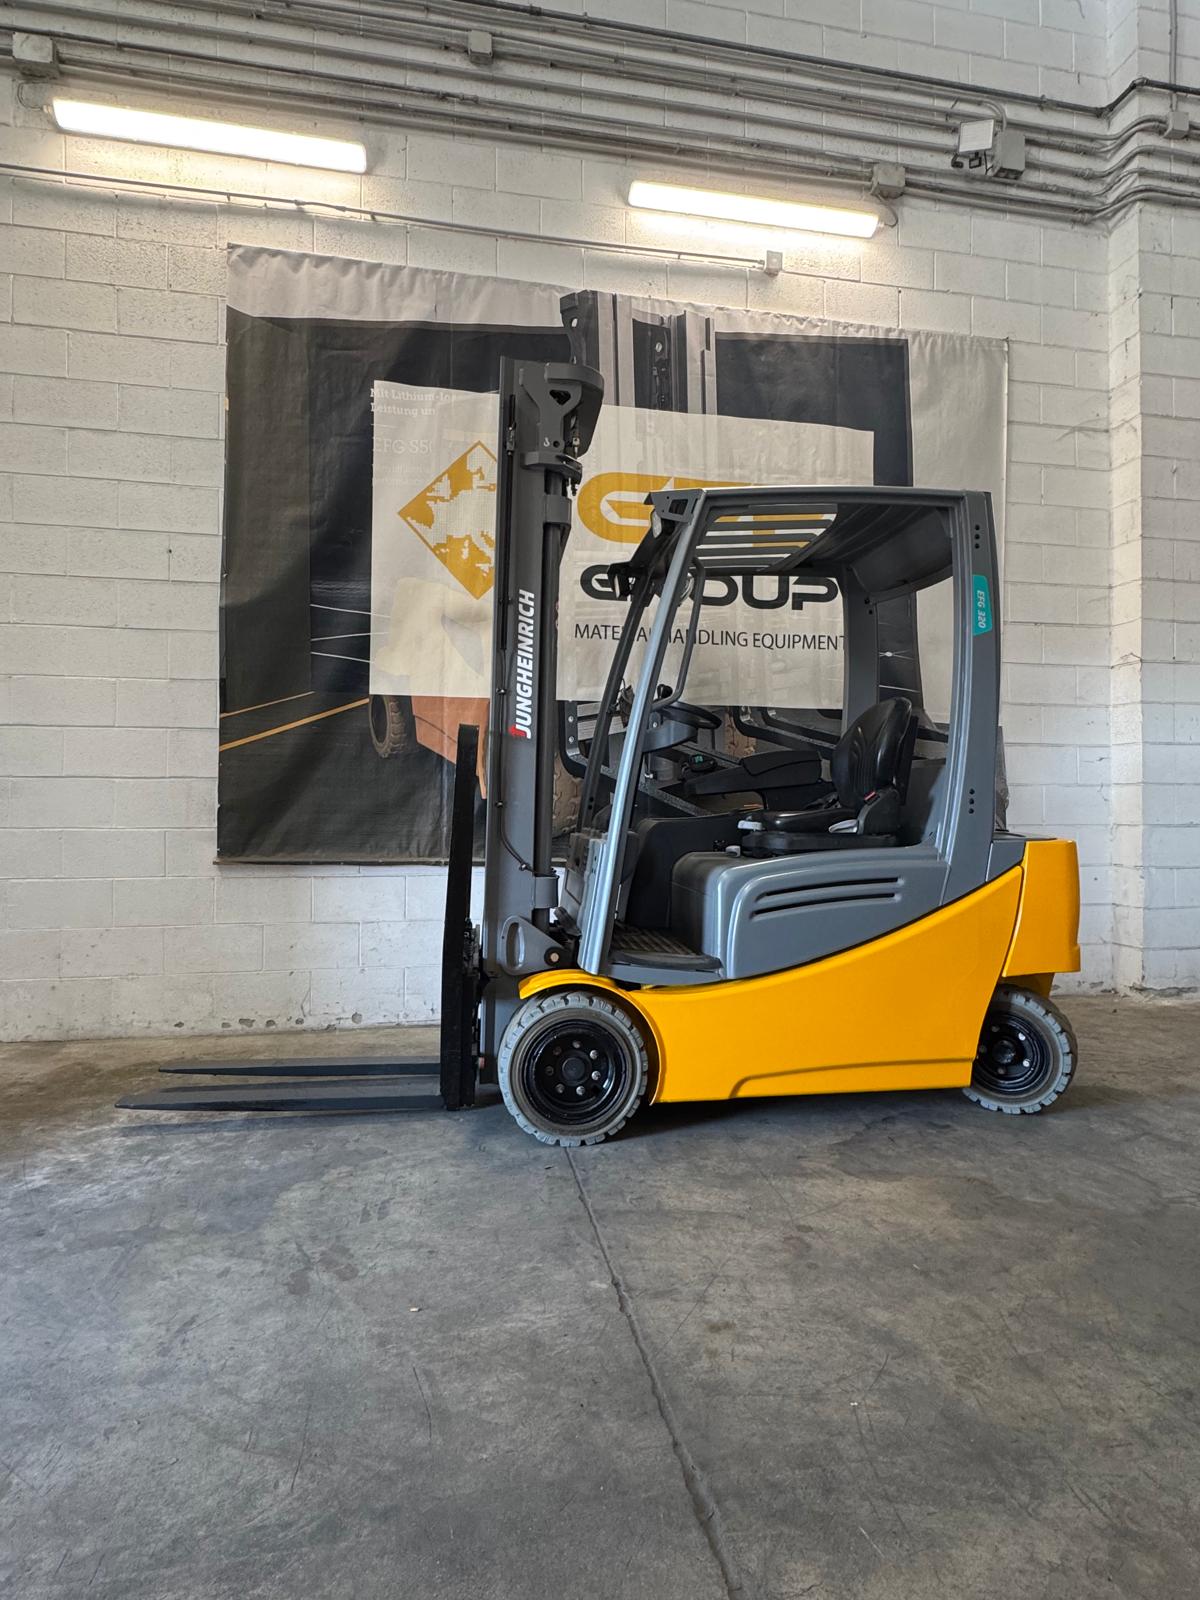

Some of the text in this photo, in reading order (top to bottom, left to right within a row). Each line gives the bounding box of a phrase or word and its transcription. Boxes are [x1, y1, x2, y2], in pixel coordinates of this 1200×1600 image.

[579, 563, 839, 612] GOUP
[976, 590, 986, 628] EFG 320
[574, 623, 652, 643] MATEA
[667, 627, 749, 648] ADLING
[510, 588, 536, 740] JUNGHEINRICH
